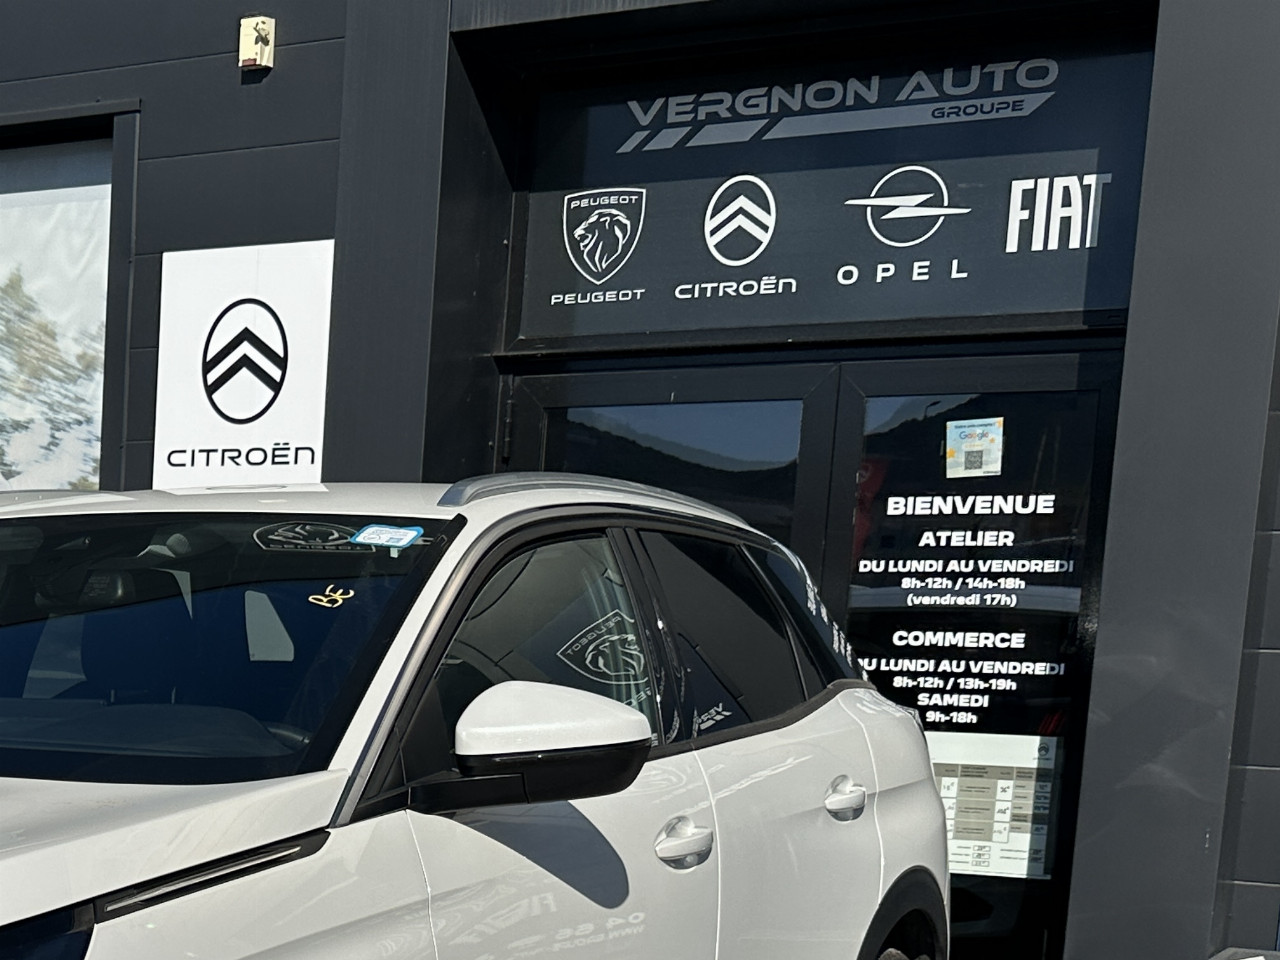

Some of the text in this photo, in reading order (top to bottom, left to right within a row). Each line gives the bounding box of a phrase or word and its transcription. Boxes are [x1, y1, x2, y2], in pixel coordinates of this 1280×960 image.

[627, 58, 1059, 127] VERGNON AUTO
[931, 99, 1025, 119] GROUPE
[570, 194, 639, 209] PEUGEOT
[1005, 173, 1112, 253] FIAT
[675, 276, 797, 299] CITROËN
[551, 288, 645, 305] PEUGEOT
[959, 430, 989, 441] Google
[167, 442, 315, 467] CITROËN
[886, 495, 1056, 515] BIENVENUE
[918, 530, 1015, 546] ATELIER
[858, 560, 1074, 573] DU LUNDI AU VENDREDI
[901, 577, 952, 589] 8h-12h
[965, 577, 1026, 589] 14h-18h
[906, 593, 1018, 607] (vendredi 17h)
[892, 630, 1026, 648] COMMERCE
[880, 658, 935, 672] LUNDI
[937, 660, 966, 673] AU
[968, 661, 1065, 675] VENDREDI
[893, 676, 944, 688] 8h-12h
[957, 678, 1017, 690] 13h-19h
[917, 693, 989, 707] SAMEDI
[925, 711, 977, 723] 9h-18h
